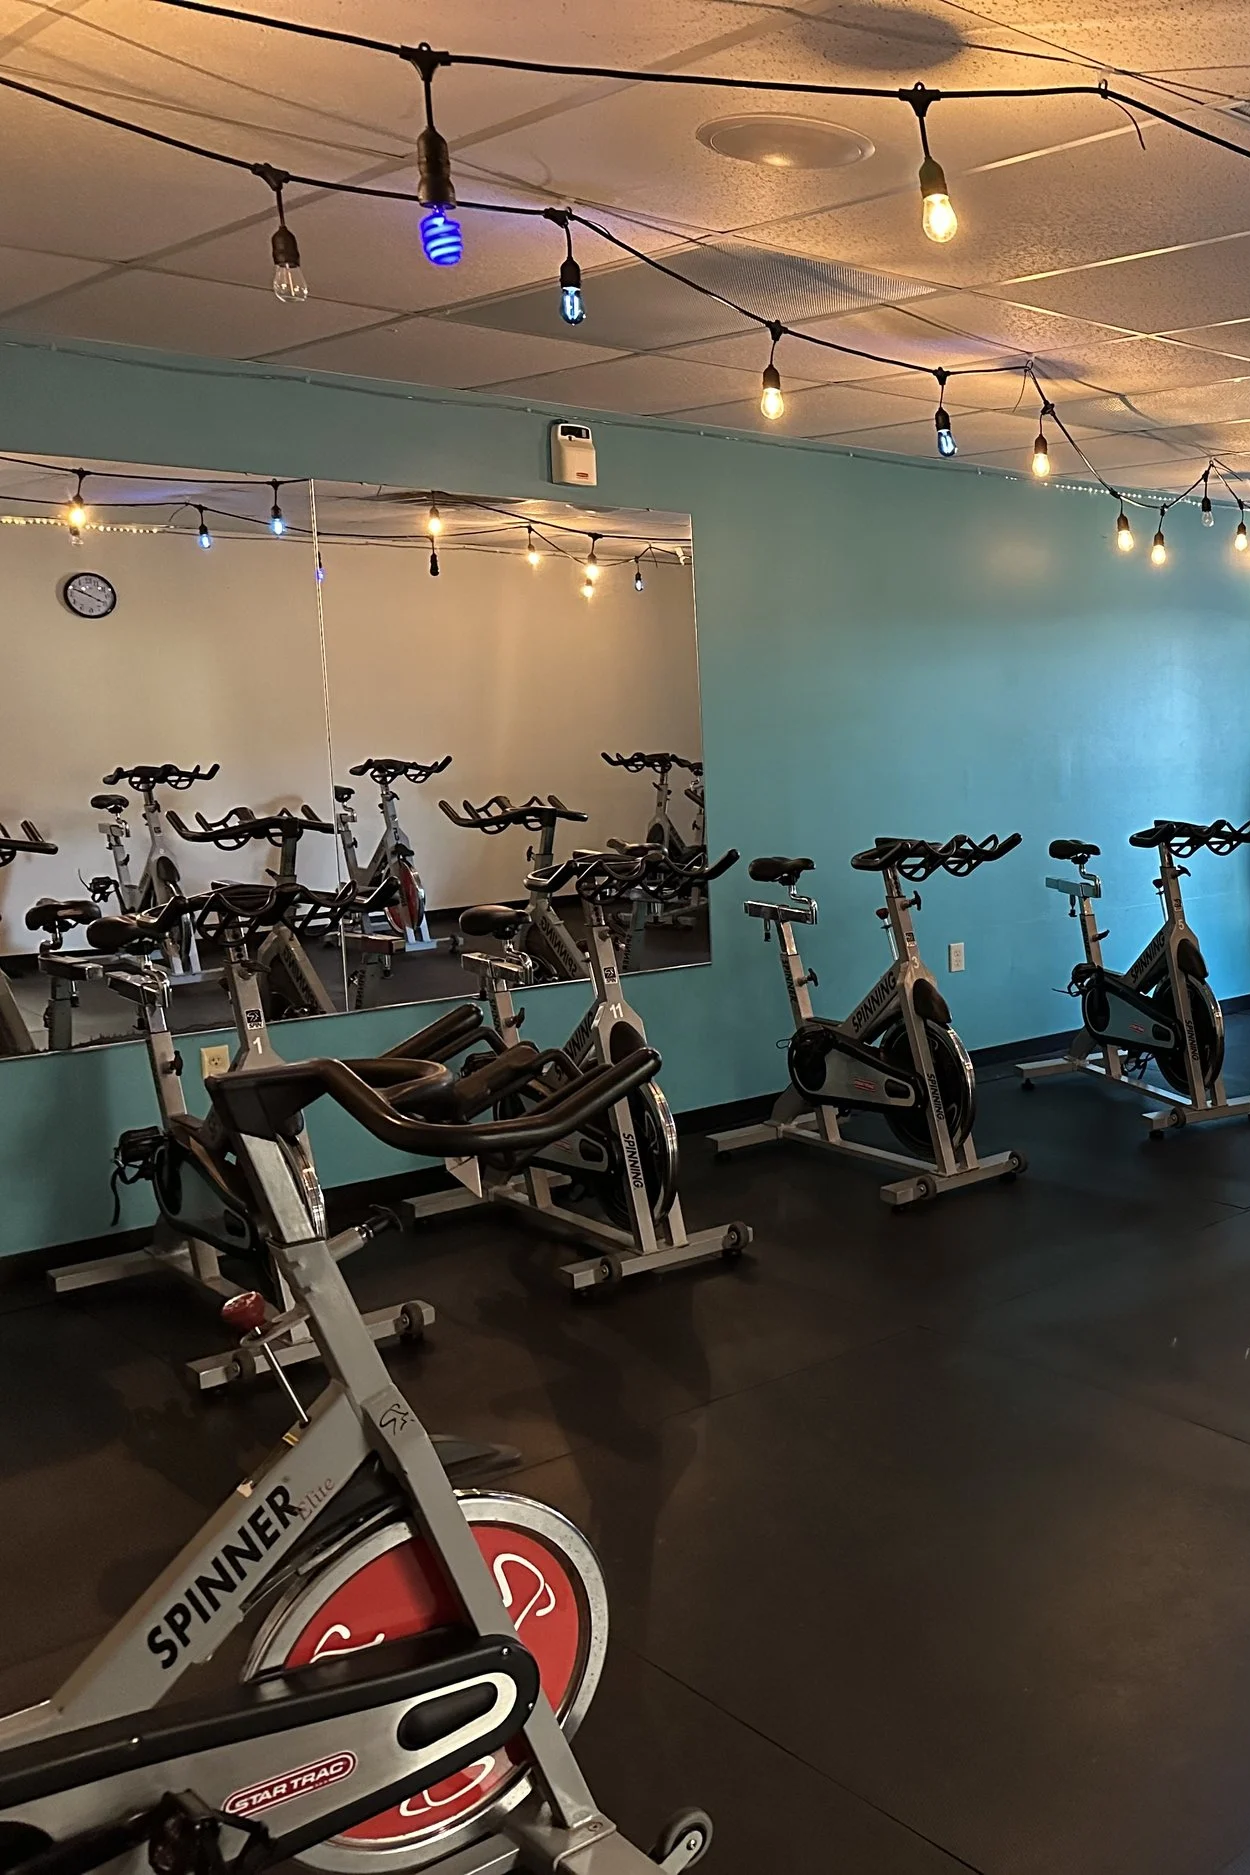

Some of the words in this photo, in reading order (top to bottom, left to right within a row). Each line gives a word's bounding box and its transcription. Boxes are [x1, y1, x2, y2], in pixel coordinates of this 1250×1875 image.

[1178, 920, 1185, 930] 5
[912, 956, 920, 969] 3
[610, 1003, 624, 1019] 11
[852, 971, 897, 1032] SPINNING
[253, 1037, 263, 1054] 1
[1185, 1020, 1199, 1060] SPINNING
[927, 1073, 945, 1120] SPINNING
[623, 1133, 644, 1189] SPINNING
[298, 1478, 336, 1522] Elite
[147, 1485, 302, 1670] SPINNER
[235, 1784, 288, 1809] STAR
[290, 1762, 345, 1789] TRAC
